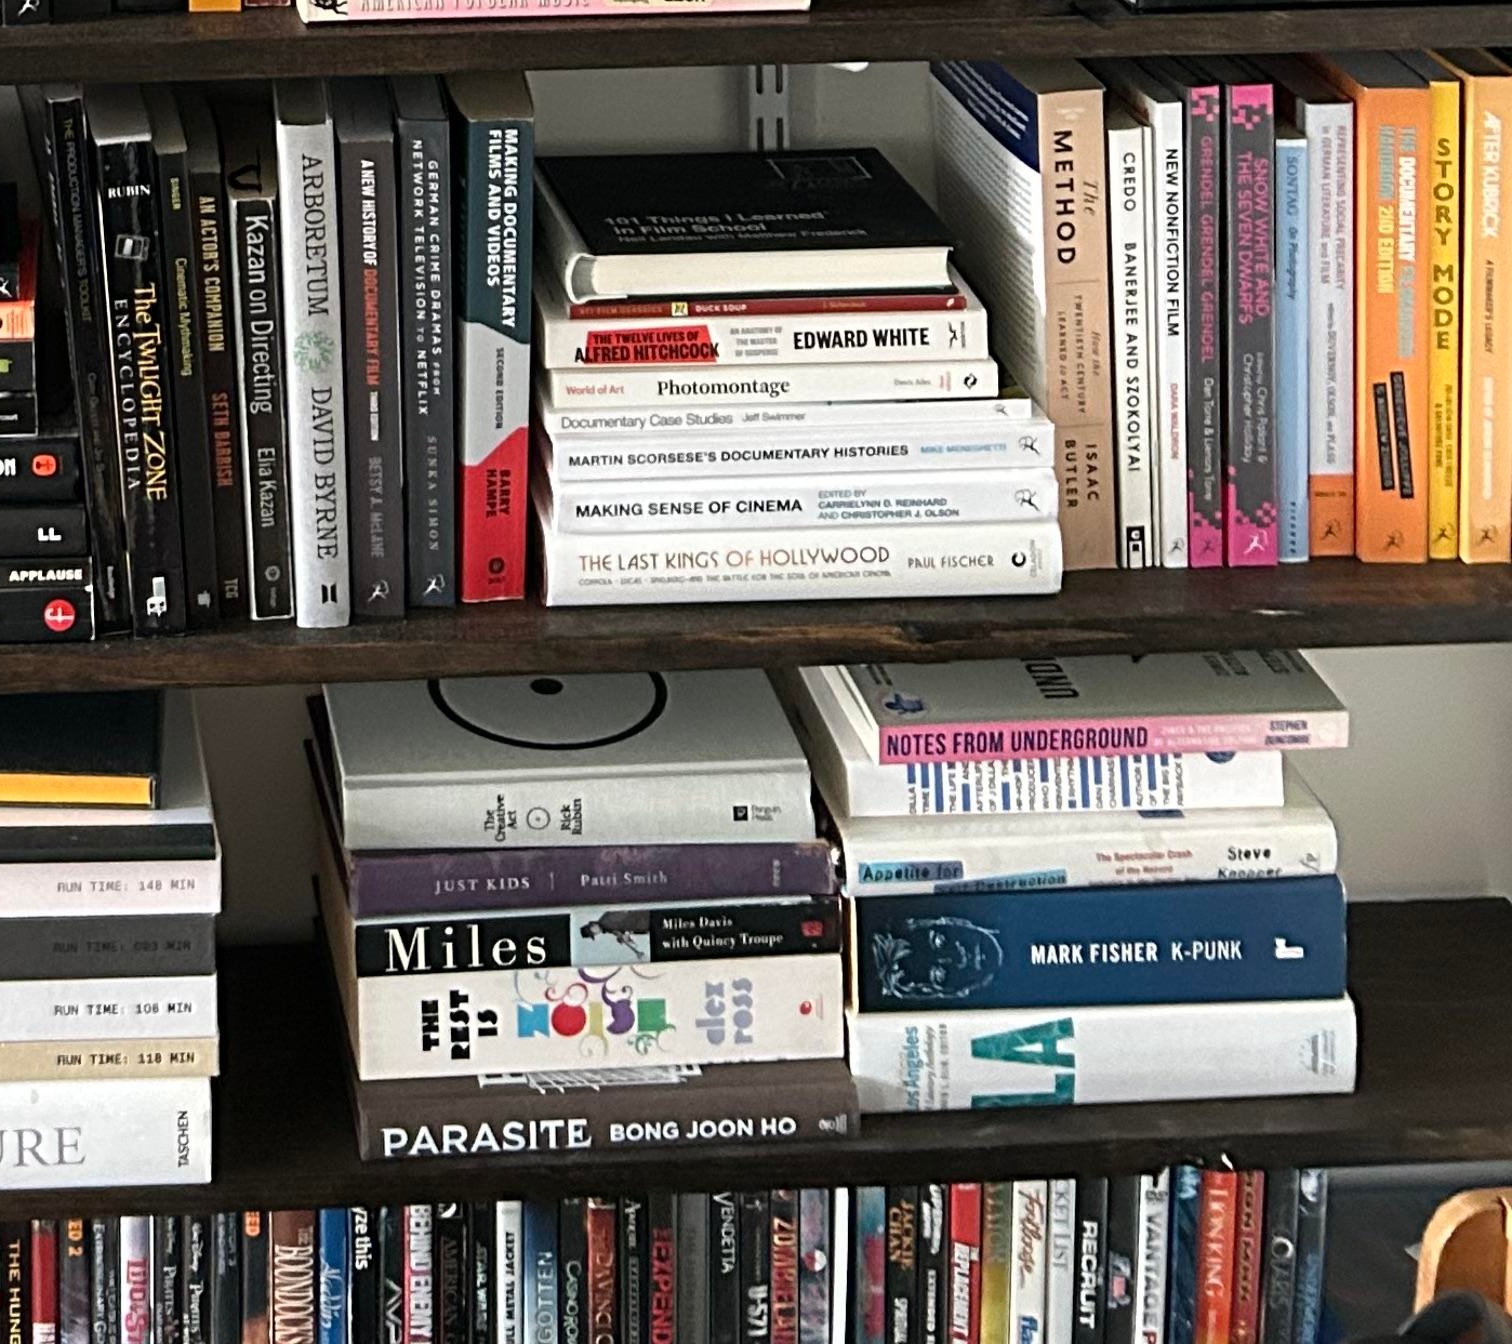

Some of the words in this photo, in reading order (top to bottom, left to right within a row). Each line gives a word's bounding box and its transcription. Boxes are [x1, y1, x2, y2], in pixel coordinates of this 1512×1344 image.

[1054, 130, 1076, 265] METHOD
[302, 154, 329, 316] ARBORETUM
[793, 330, 867, 350] EDWARD
[873, 327, 929, 347] WHITE
[657, 378, 789, 398] Photomontage
[311, 387, 334, 465] DAVID
[316, 474, 337, 559] BYRNE
[887, 731, 947, 756] NOTES
[953, 729, 1006, 754] FROM
[1011, 723, 1148, 753] UNDERGROUND
[384, 923, 548, 974] Miles
[1030, 944, 1085, 967] MARK
[1089, 942, 1158, 966] FISHER
[1170, 940, 1243, 963] K-PUNK
[177, 1110, 189, 1168] TASCHEN
[381, 1118, 592, 1158] PARASITE
[609, 1121, 680, 1142] BONG
[686, 1118, 754, 1140] JOON
[758, 1115, 796, 1137] HO
